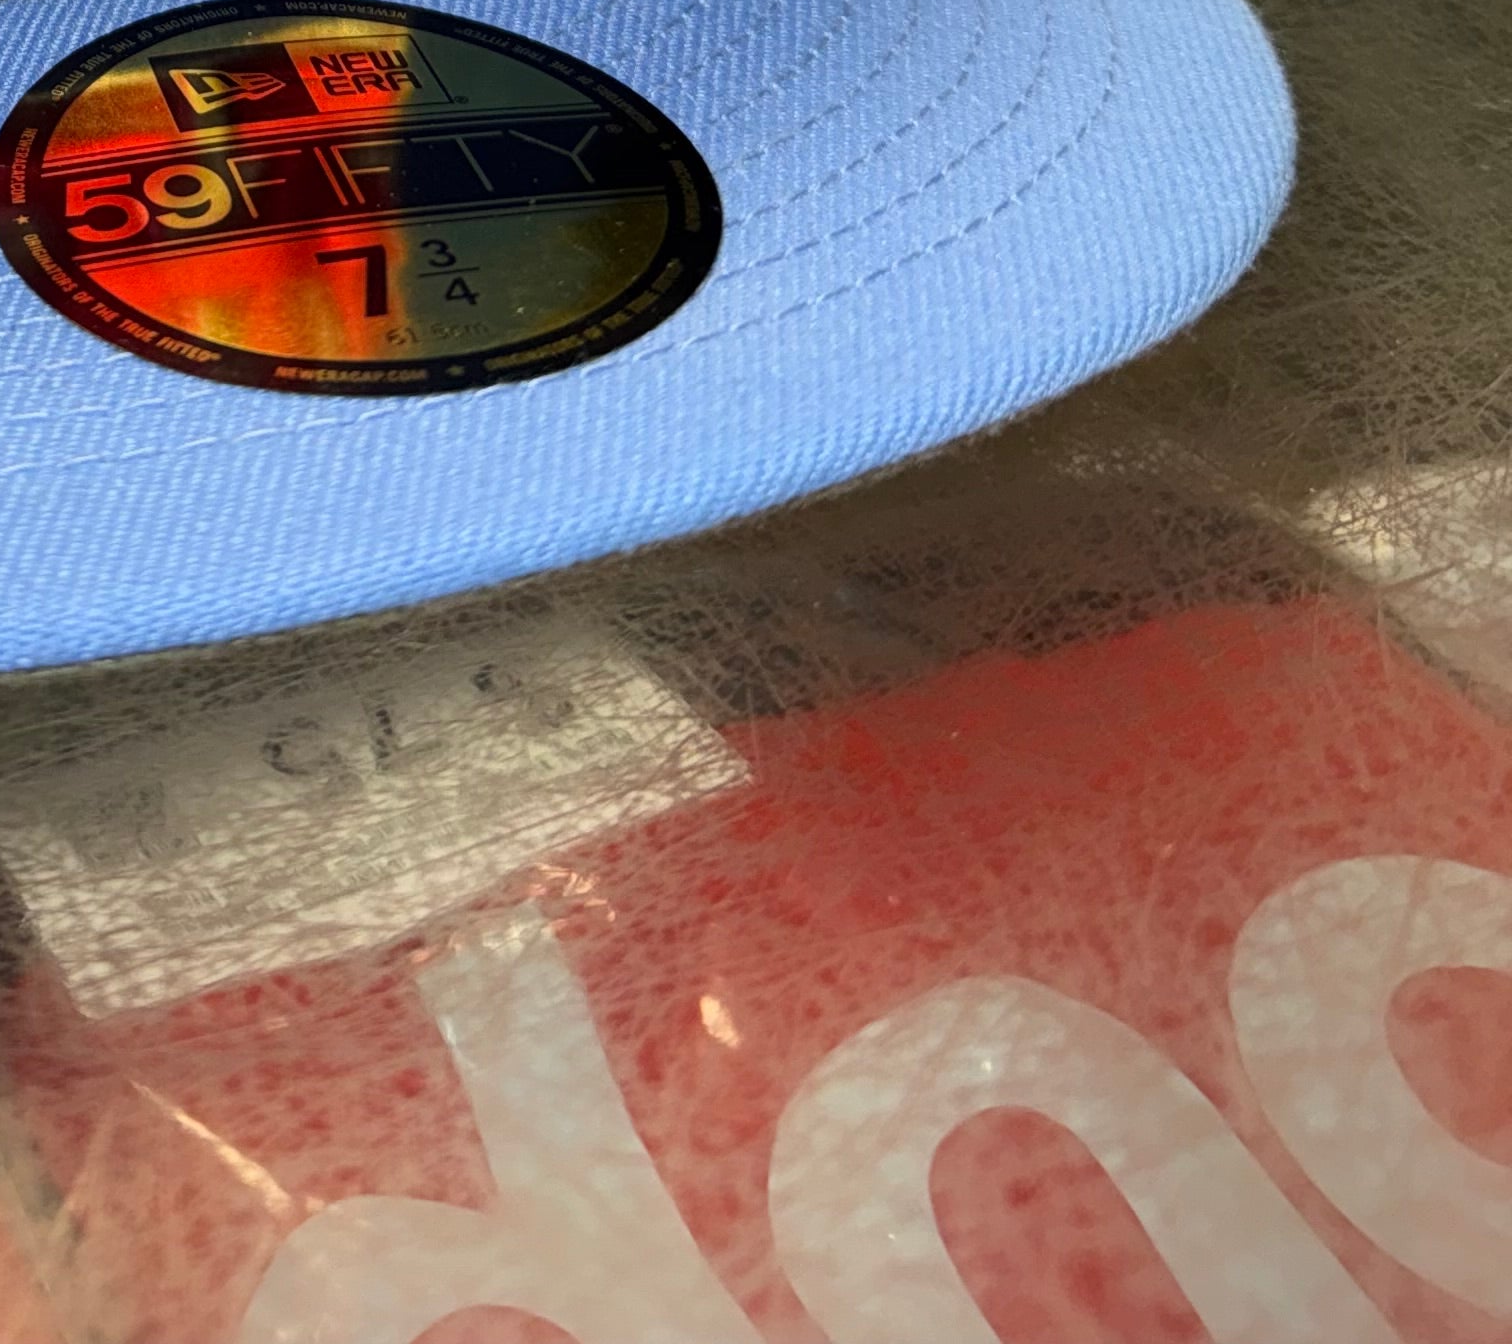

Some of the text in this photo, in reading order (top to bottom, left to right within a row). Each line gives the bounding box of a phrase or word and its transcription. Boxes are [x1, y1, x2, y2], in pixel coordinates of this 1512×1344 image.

[309, 49, 409, 76] NEW
[322, 70, 423, 97] ERA
[10, 127, 39, 204] NEWERACAP.COM
[64, 125, 600, 243] 59FIFTY
[23, 233, 79, 293] ORIGINATORS
[90, 302, 120, 323] THE
[118, 318, 158, 343] TRUE
[314, 244, 388, 318] 7
